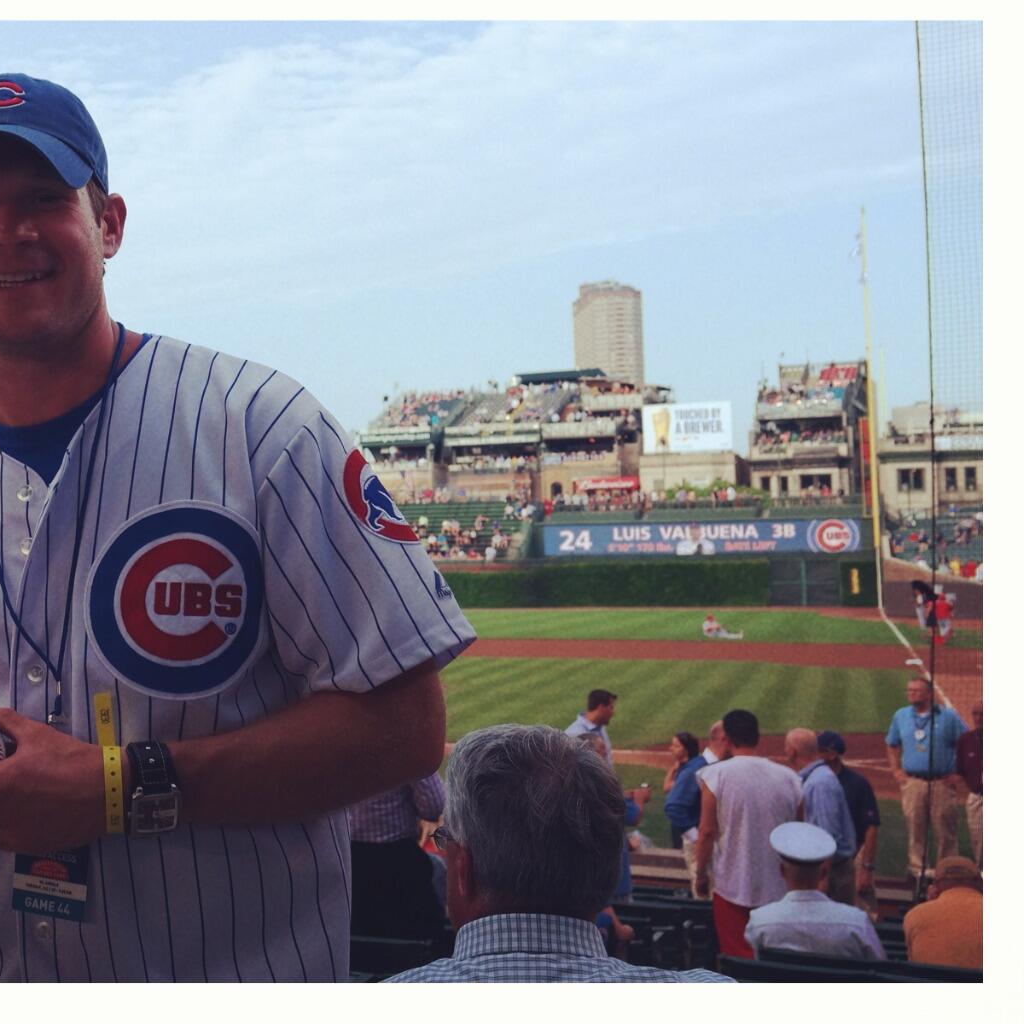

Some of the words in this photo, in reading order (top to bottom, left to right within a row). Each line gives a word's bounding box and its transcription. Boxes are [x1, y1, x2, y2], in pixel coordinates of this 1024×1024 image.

[559, 529, 593, 552] 24
[612, 525, 652, 542] LUIS
[772, 522, 796, 539] 3B
[24, 896, 56, 913] GAME
[57, 902, 71, 915] 44
